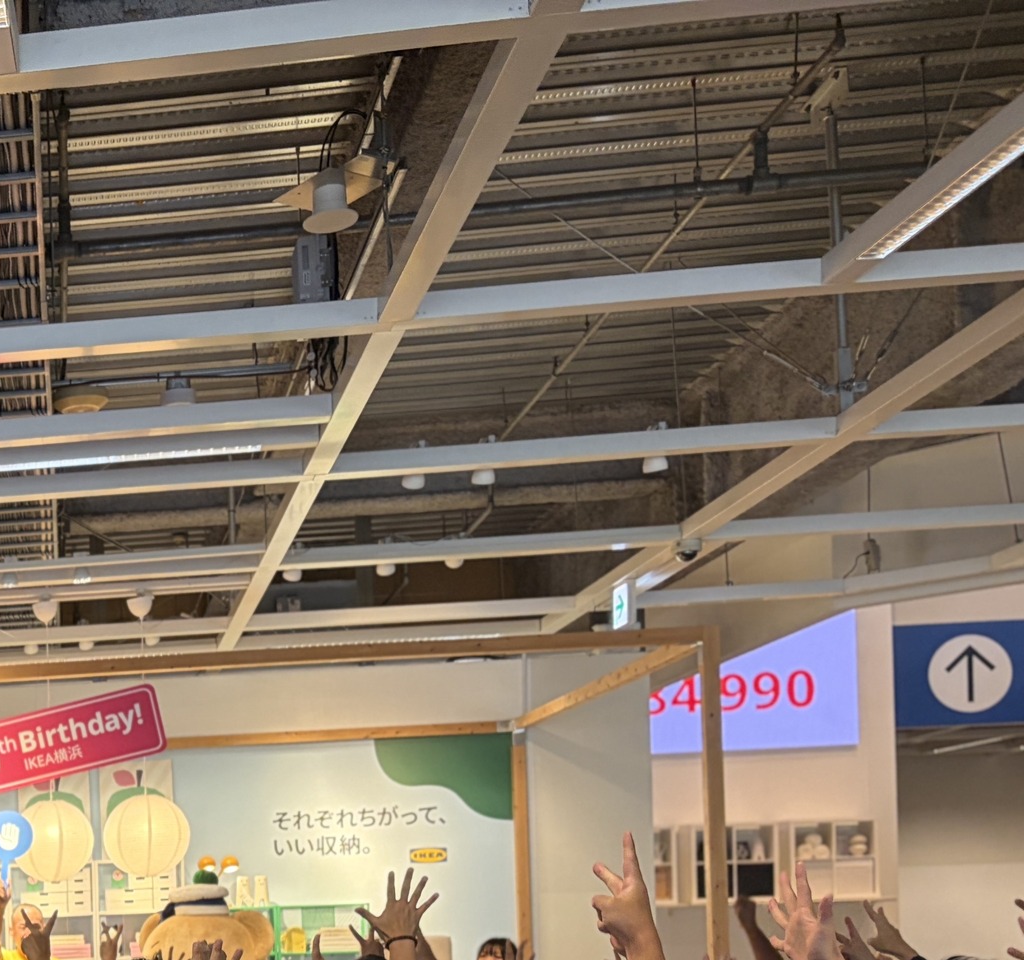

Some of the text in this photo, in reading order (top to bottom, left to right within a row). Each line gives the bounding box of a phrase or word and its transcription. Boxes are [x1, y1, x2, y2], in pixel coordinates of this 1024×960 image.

[18, 702, 145, 754] Birthday!
[23, 744, 83, 771] IKEA横浜
[272, 805, 446, 831] それぞれちがって、
[273, 834, 371, 857] いい収納。
[412, 850, 445, 861] IKEA
